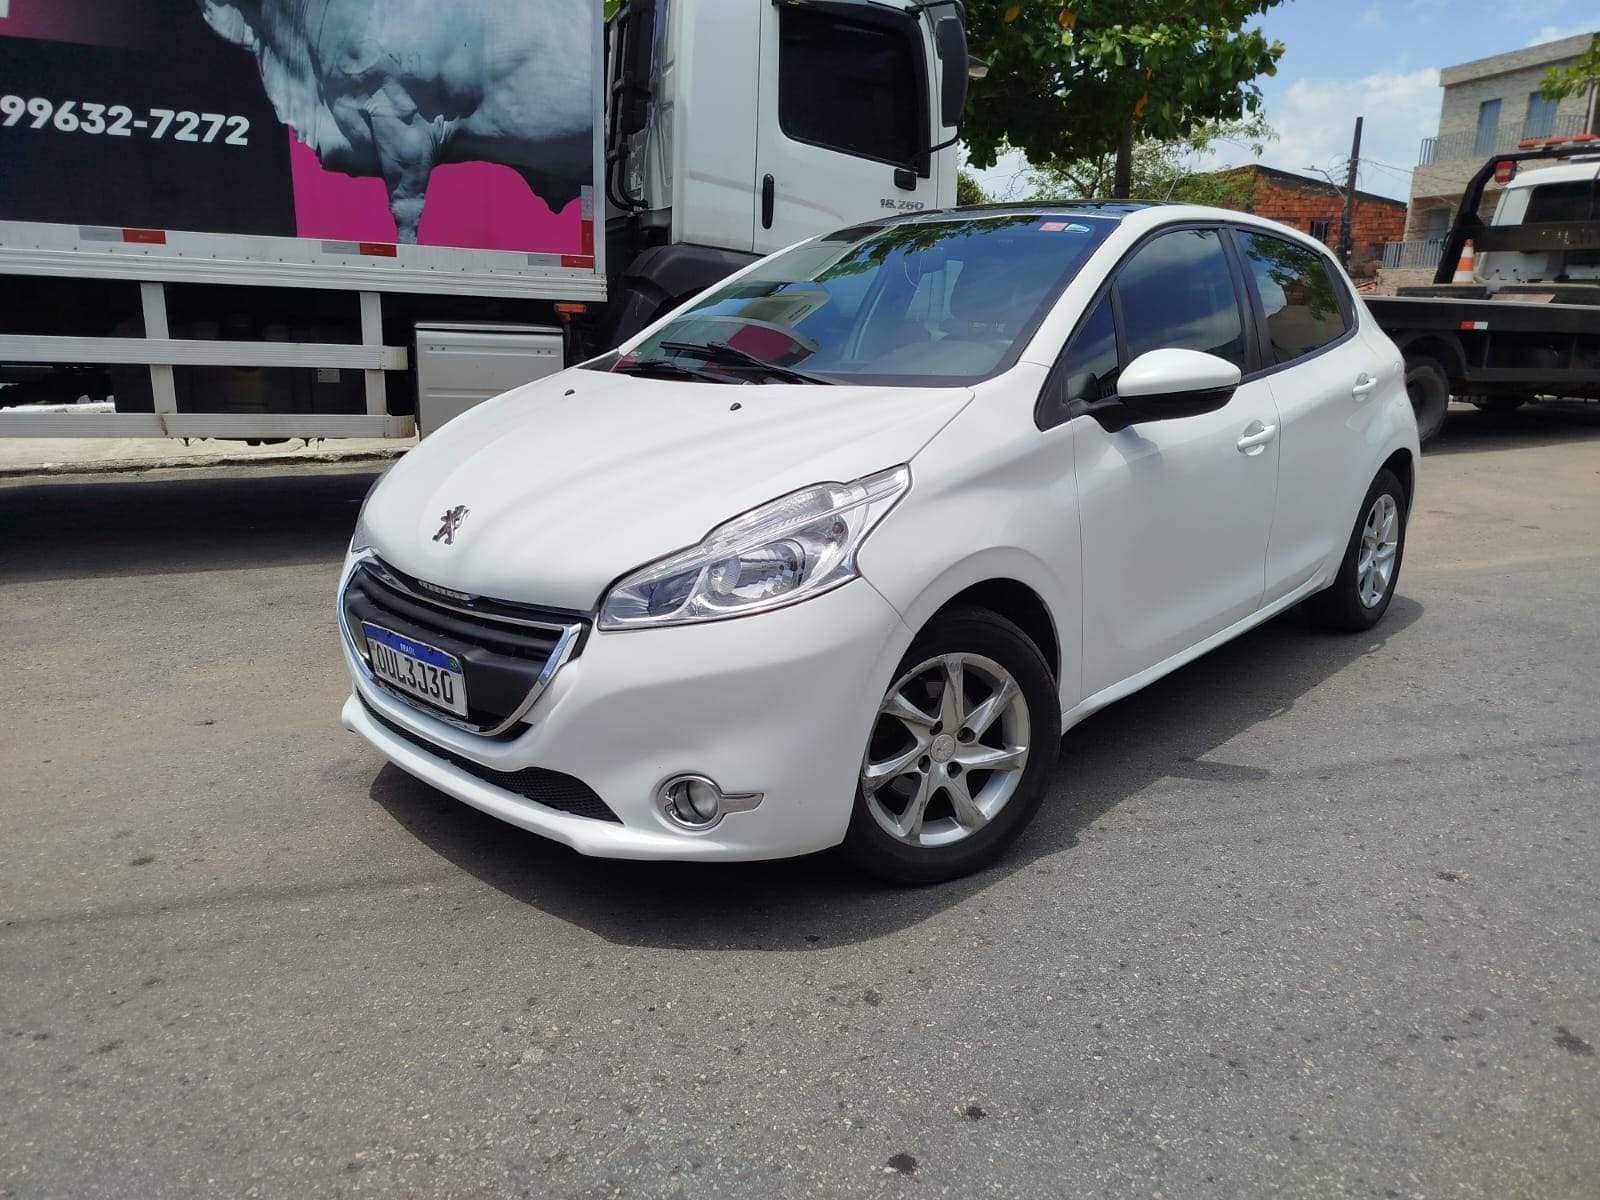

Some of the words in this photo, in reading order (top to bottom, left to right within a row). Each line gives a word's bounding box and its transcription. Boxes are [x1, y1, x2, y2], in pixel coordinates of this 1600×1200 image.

[0, 95, 250, 145] 99632-7272
[880, 199, 925, 210] 18.260
[377, 644, 454, 705] OUL3J30
